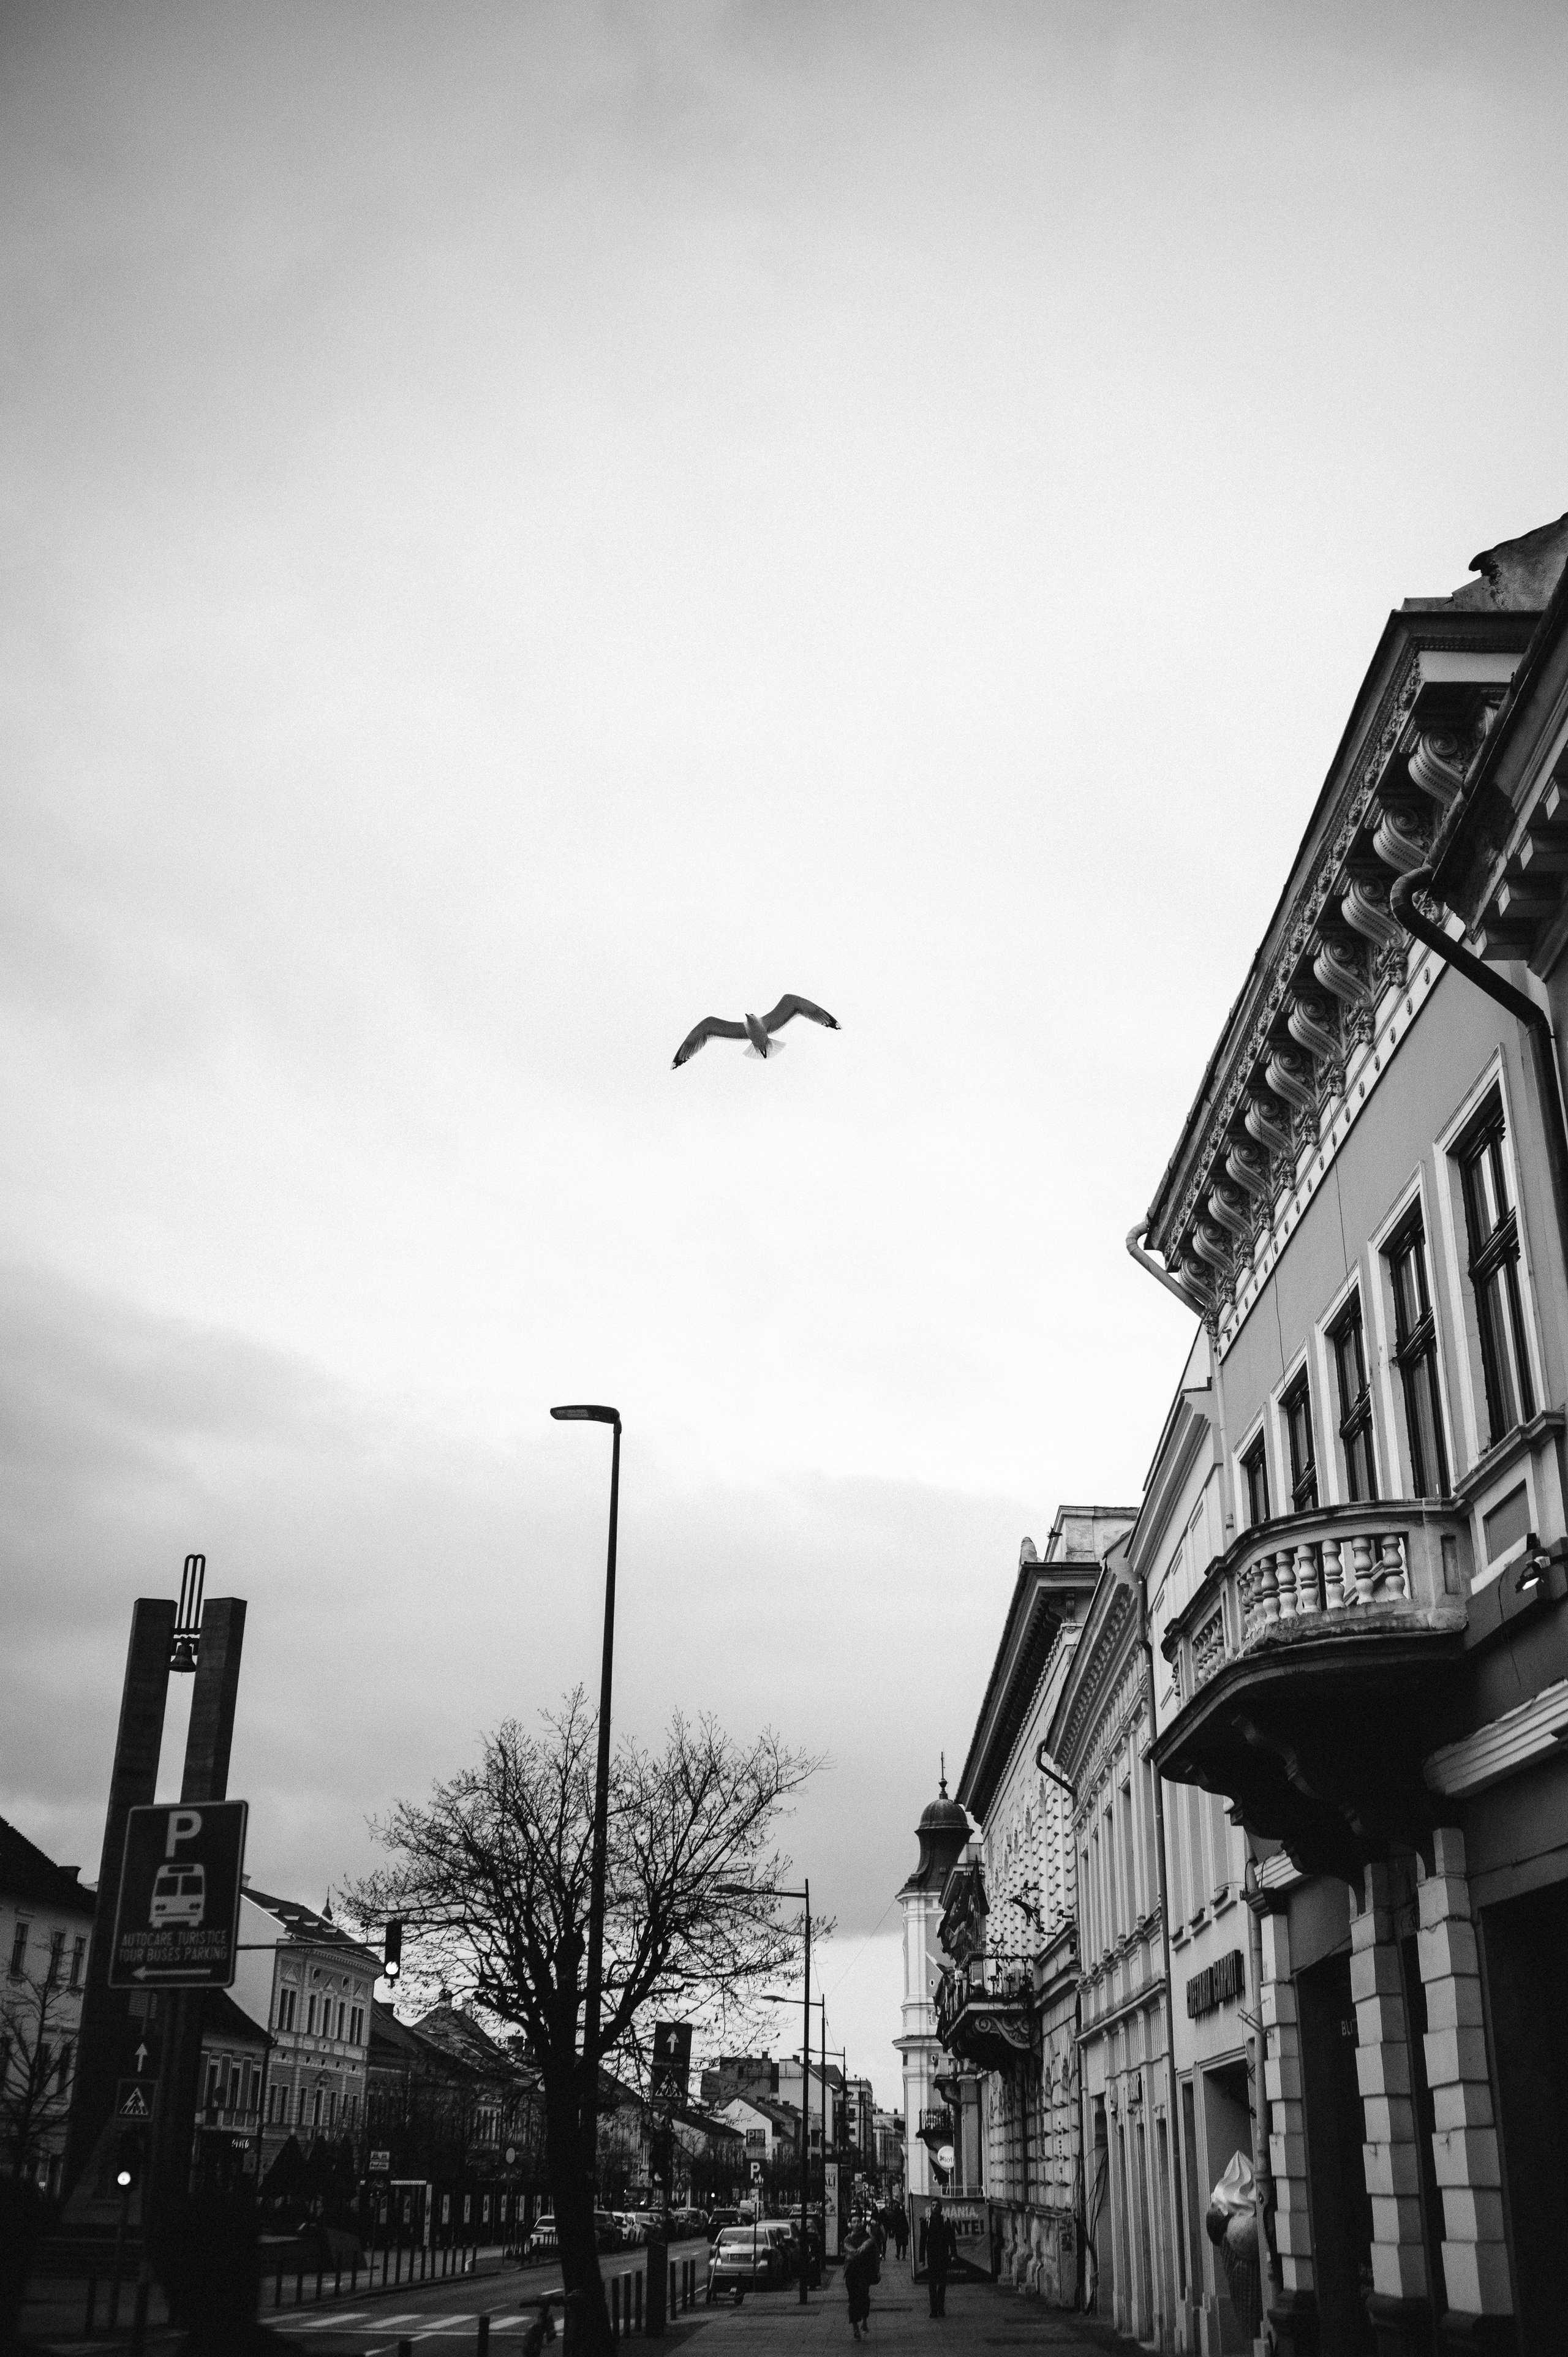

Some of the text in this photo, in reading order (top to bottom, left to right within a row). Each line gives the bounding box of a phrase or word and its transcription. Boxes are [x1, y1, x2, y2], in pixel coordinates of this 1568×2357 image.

[165, 1810, 202, 1858] P
[121, 1929, 227, 1947] AUTOCARE TURISTICE
[119, 1946, 227, 1963] TOUR BUSES PARKING
[750, 2162, 761, 2179] P
[925, 2204, 978, 2219] RMÂNIA,
